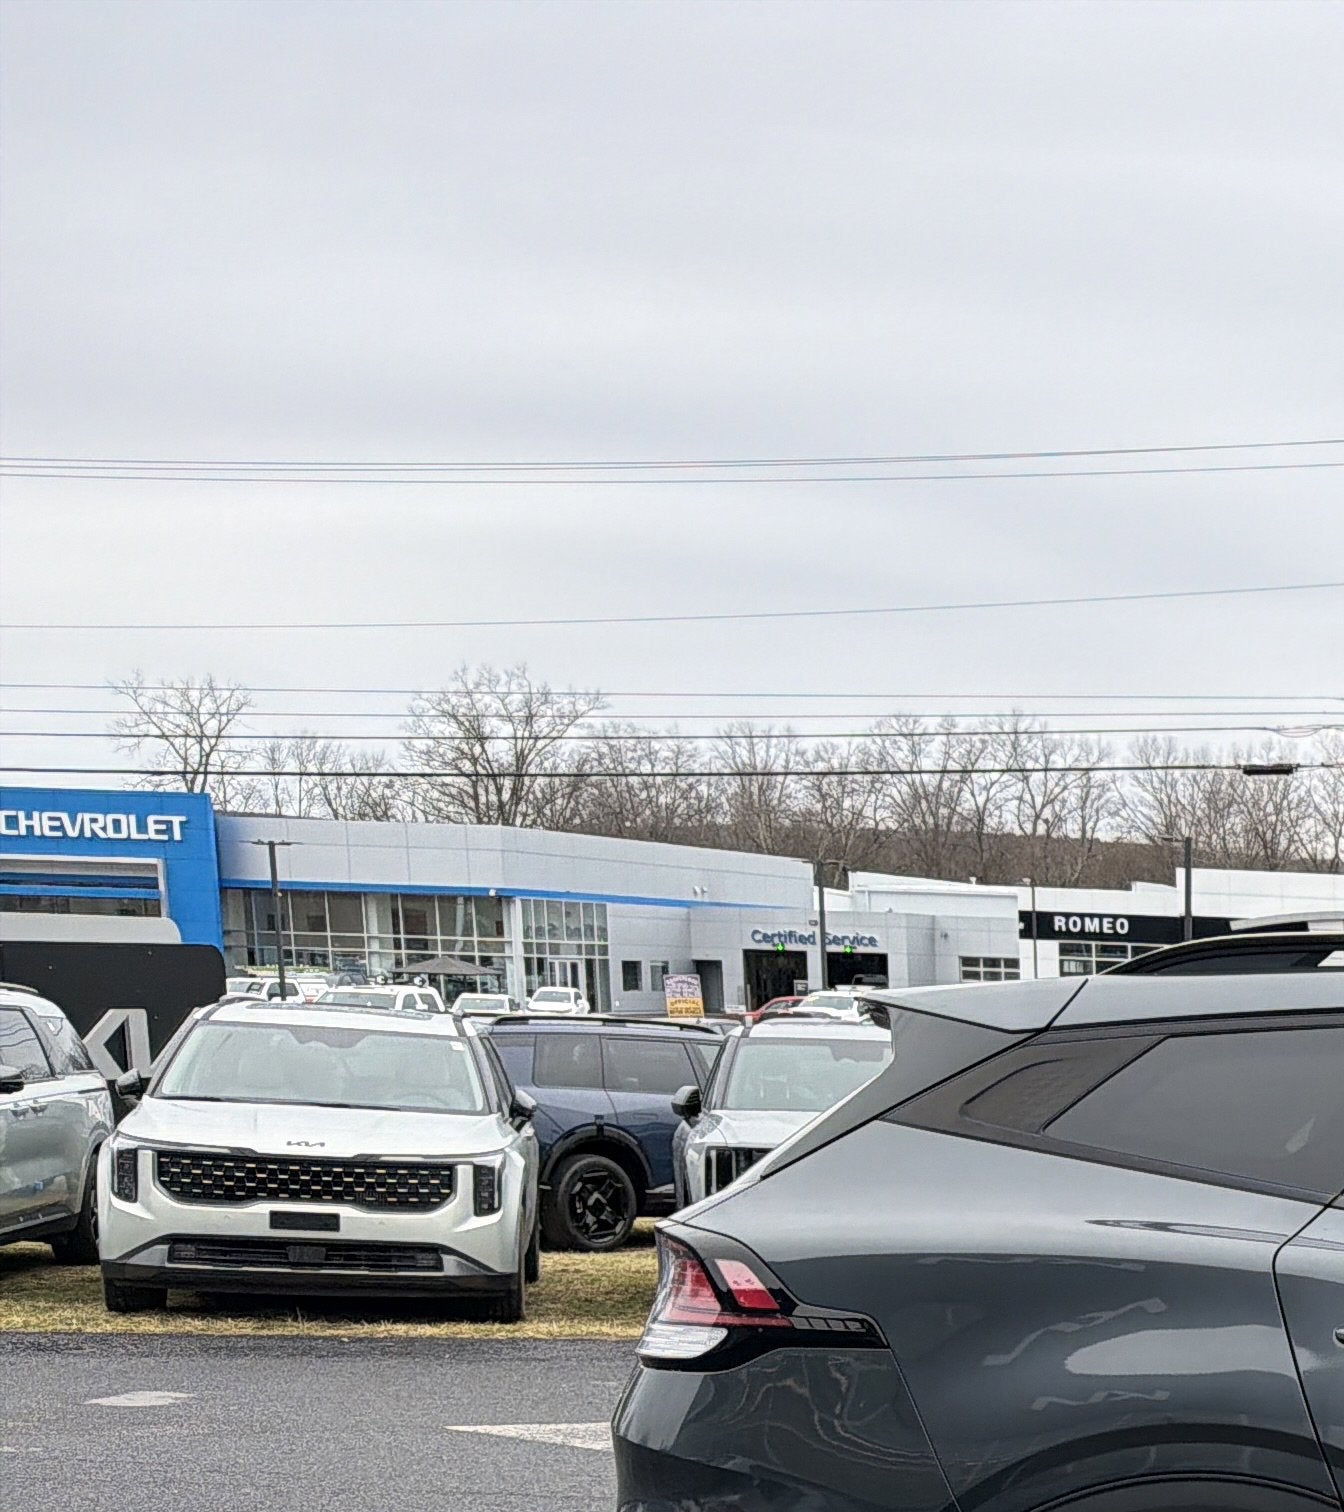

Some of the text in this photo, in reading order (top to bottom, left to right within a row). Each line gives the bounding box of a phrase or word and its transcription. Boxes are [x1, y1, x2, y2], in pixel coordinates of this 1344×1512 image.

[0, 809, 188, 841] CHEVROLET
[1053, 915, 1130, 935] ROMEO
[751, 929, 816, 947] Certified
